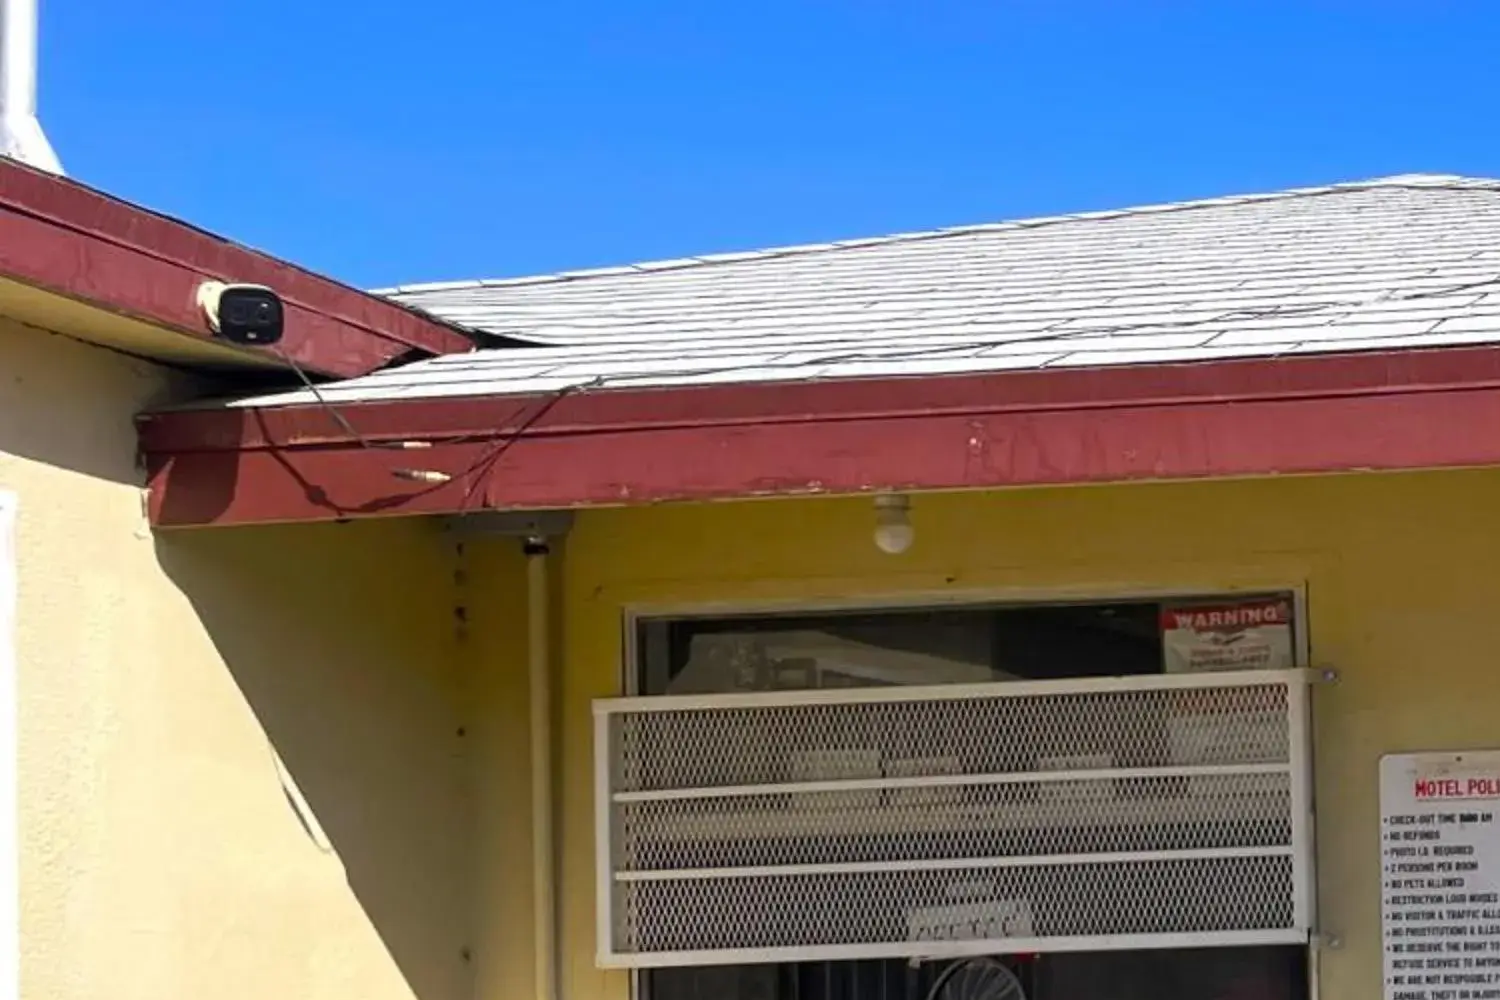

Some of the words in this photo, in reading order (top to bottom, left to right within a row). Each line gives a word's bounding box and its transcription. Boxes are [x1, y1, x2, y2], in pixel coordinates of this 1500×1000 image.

[1175, 605, 1279, 627] WARNING
[1415, 779, 1463, 797] MOTEL
[1427, 878, 1464, 888] ALLOWED
